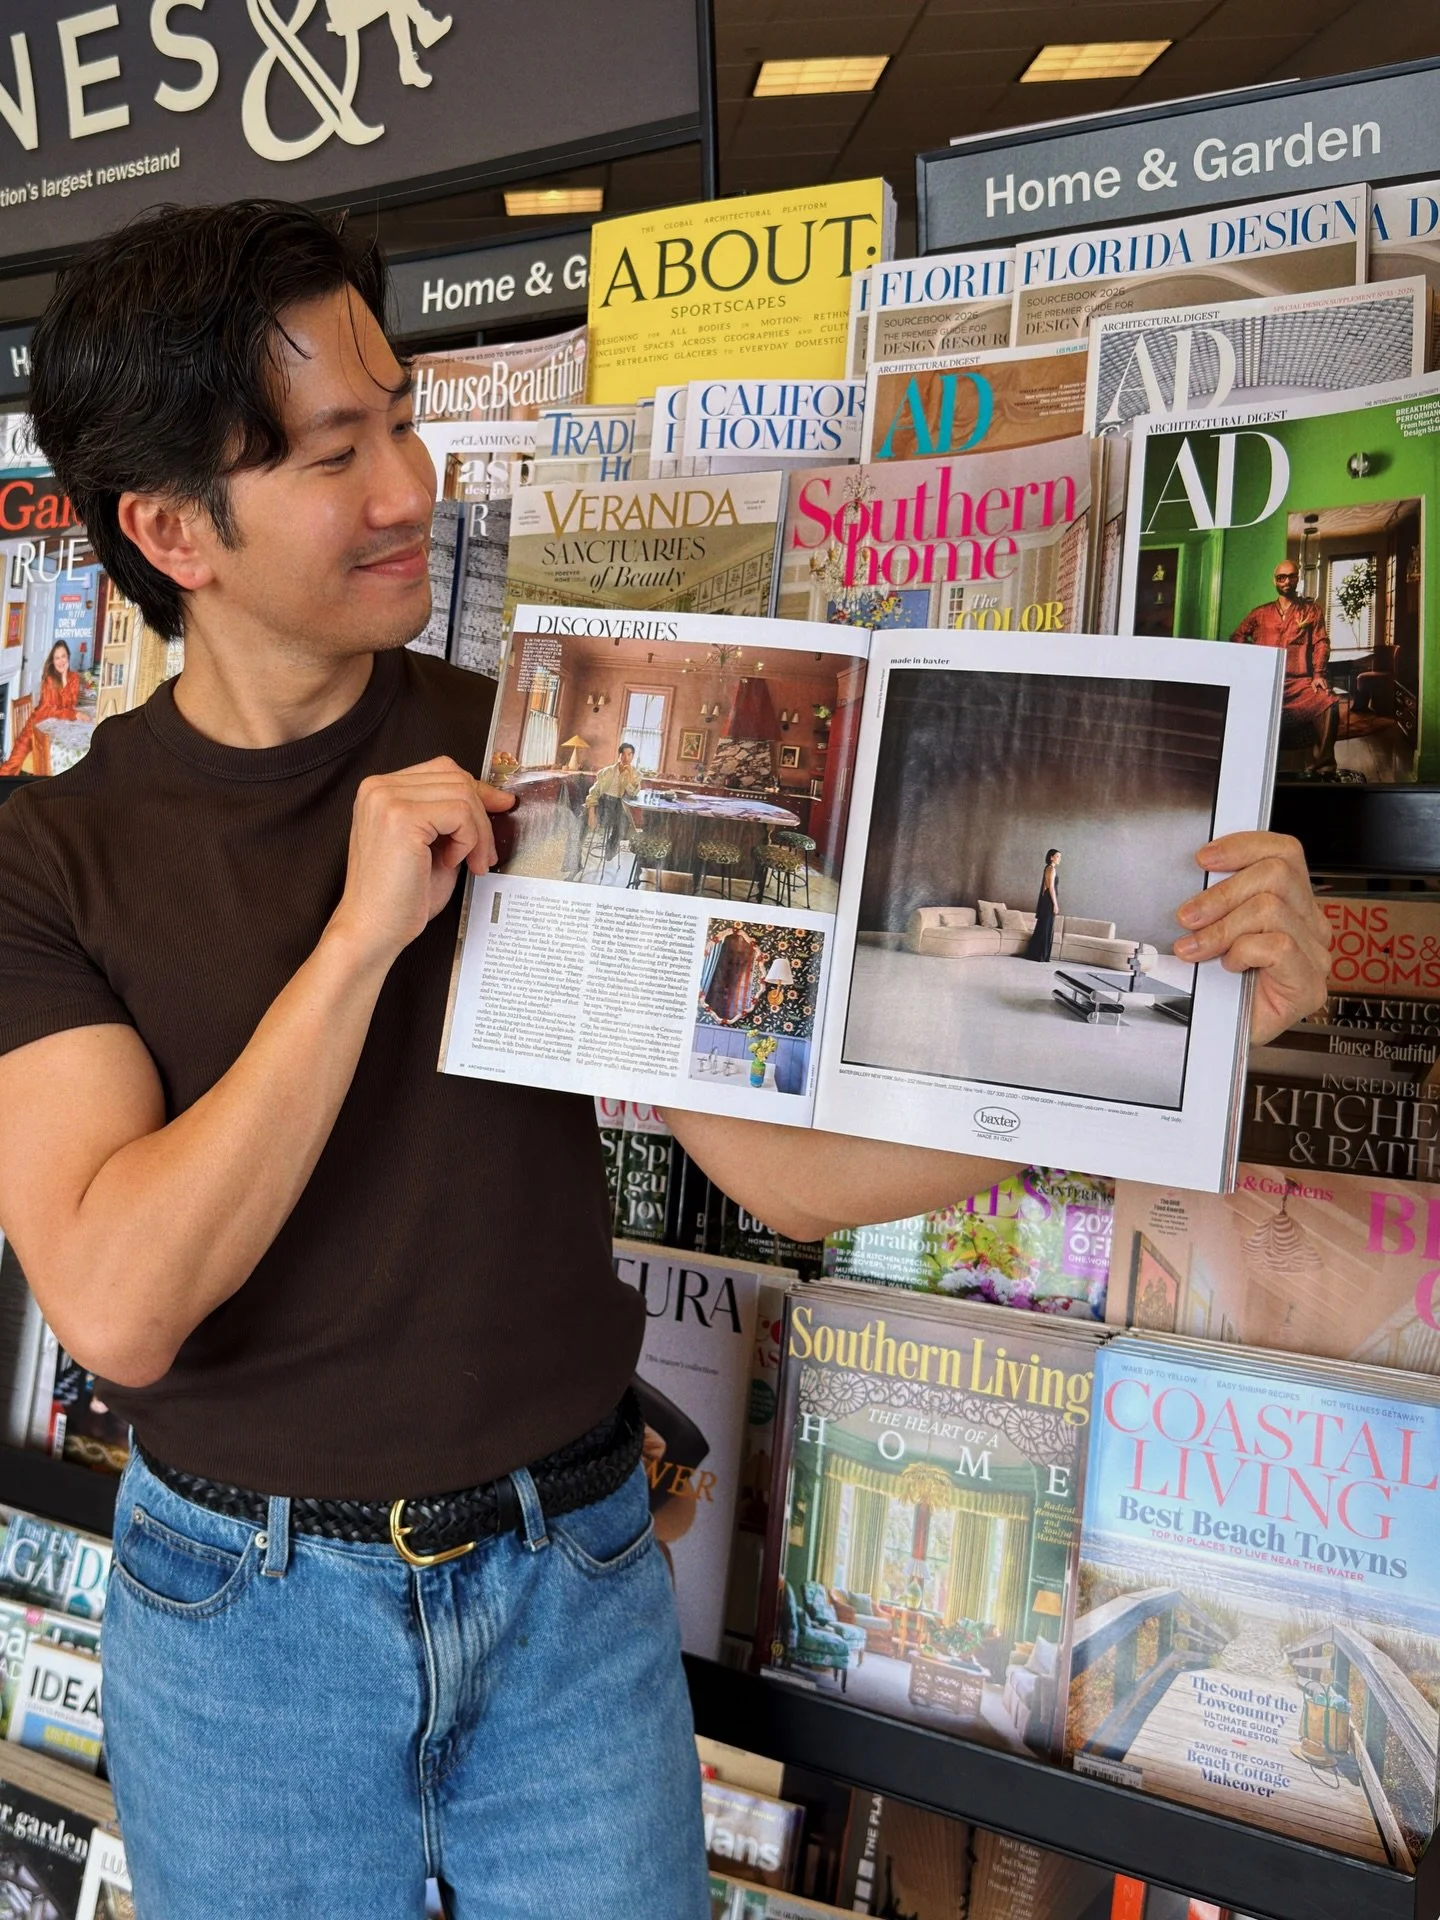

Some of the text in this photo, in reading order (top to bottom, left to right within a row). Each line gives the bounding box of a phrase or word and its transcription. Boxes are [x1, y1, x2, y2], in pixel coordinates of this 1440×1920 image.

[42, 171, 93, 198] largest
[97, 148, 180, 185] newsstand
[985, 120, 1382, 218] Home & Garden
[664, 218, 693, 230] GLOBAL
[704, 209, 771, 224] ARCHITECTURAL
[782, 202, 828, 213] PLATFORM
[1021, 195, 1361, 287] FLORIDA DESIGN
[422, 271, 514, 314] Home
[524, 261, 553, 297] &
[879, 259, 1015, 307] FLORID
[1026, 287, 1125, 308] SOURCEBOOK 2026
[671, 295, 786, 319] SPORTSCAPES
[884, 311, 979, 329] SOURCEBOOK 2026
[1026, 299, 1133, 321] THE PREMIER GUIDE FOR
[1101, 311, 1220, 332] ARCHITECTURAL DIGEST
[597, 333, 639, 347] DESIGNING
[671, 326, 687, 336] ALL
[698, 323, 731, 333] BODIES
[884, 323, 986, 342] THE PREMIER GUIDE FOR
[1026, 316, 1082, 335] DESIGN
[596, 345, 637, 358] INCLUSIVE
[644, 341, 674, 352] SPACES
[682, 336, 716, 347] ACROSS
[724, 329, 790, 344] GEOGRAPHIES
[616, 336, 845, 368] RETREATING GLACIERS EVERYDAY DOMESTIC
[884, 340, 936, 356] DESIGN
[878, 356, 981, 375] ARCHITECTURAL DIGEST
[1100, 329, 1236, 424] AD
[875, 371, 995, 458] AD
[1147, 409, 1288, 435] ARCHITECTURAL DIGEST
[1400, 421, 1418, 430] From
[451, 435, 520, 447] reCLAIMING
[697, 418, 842, 451] HOMES
[1403, 428, 1426, 437] Design
[1140, 431, 1290, 534] AD
[543, 488, 739, 540] VERANDA
[792, 466, 1077, 549] Southern
[541, 536, 706, 566] SANCTUARIES
[841, 523, 1018, 588] home
[589, 567, 686, 593] of Beauty
[970, 593, 998, 609] The
[536, 615, 678, 641] DISCOVERIES
[956, 600, 1064, 632] COLOR
[55, 626, 93, 639] BARRYMORE
[923, 657, 950, 665] baxter
[1329, 1034, 1437, 1064] House Beautiful
[980, 1111, 1017, 1128] baxter
[1289, 1131, 1440, 1178] & BATH
[1259, 1177, 1334, 1201] Gardens
[788, 1305, 1094, 1427] Southern Living
[1166, 1371, 1197, 1384] YELLOW
[1217, 1380, 1300, 1402] EASY SHRIMP RECIPES
[1320, 1398, 1425, 1424] HOT WELLNESS GETAWAYS
[868, 1407, 999, 1448] THE HEART OF A
[1103, 1378, 1440, 1491] COASTAL
[1126, 1437, 1397, 1541] LIVING
[1117, 1494, 1184, 1531] Best
[1192, 1511, 1286, 1554] Beach
[1294, 1531, 1408, 1580] Towns
[1150, 1528, 1365, 1583] TOP 10 PLACES TO LIVE NEAR THE WATER
[1191, 1675, 1298, 1713] The Soul of the
[1196, 1691, 1288, 1728] Lowcountry
[1204, 1710, 1279, 1736] ULTIMATE GUIDE
[1203, 1719, 1279, 1744] TO CHARLESTON
[1194, 1741, 1228, 1756] SAVING
[1231, 1750, 1249, 1762] THE
[1187, 1749, 1291, 1788] Beach Cottage
[1201, 1768, 1275, 1798] Makeover
[13, 1811, 89, 1859] garden
